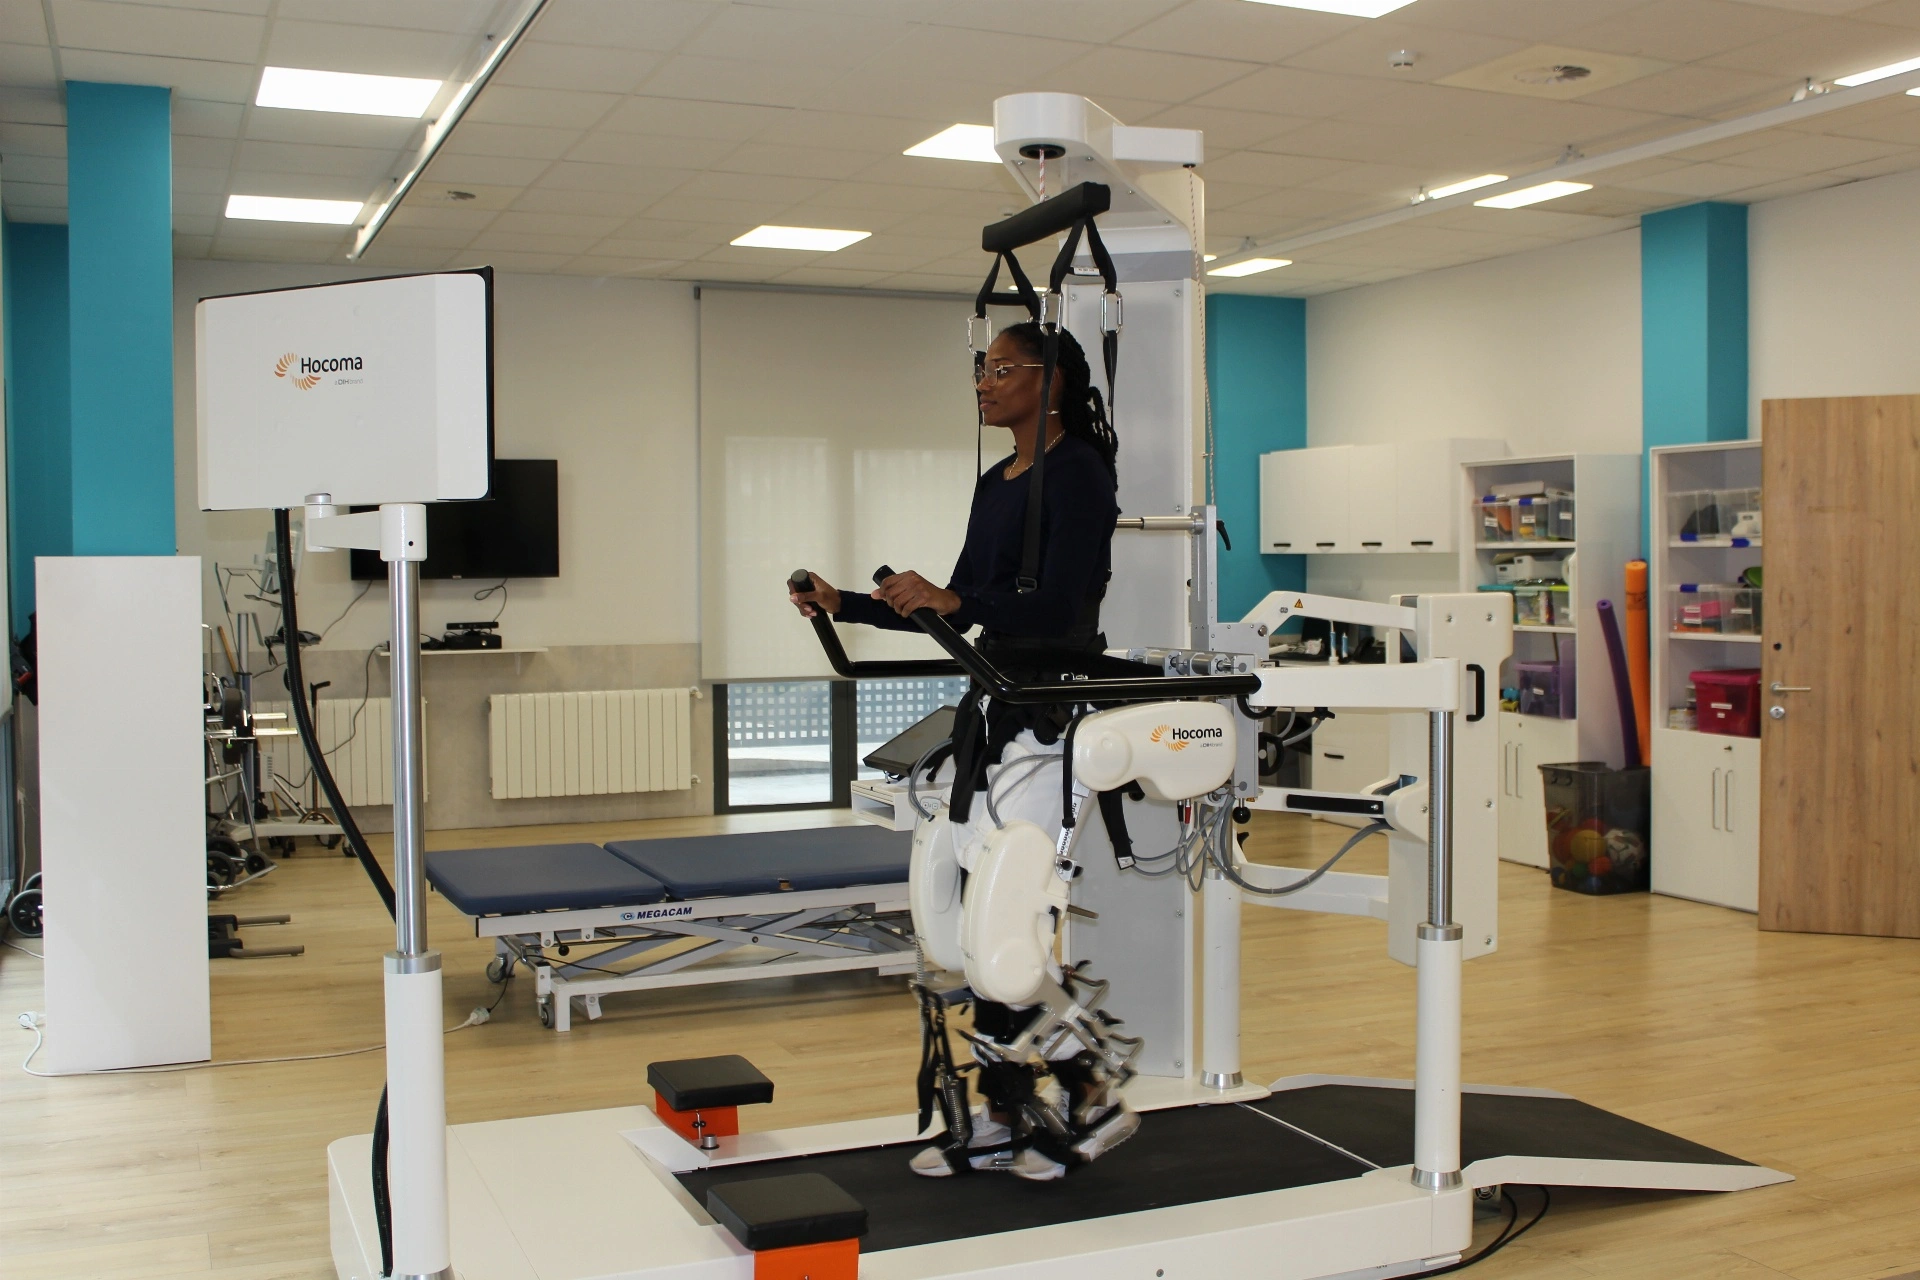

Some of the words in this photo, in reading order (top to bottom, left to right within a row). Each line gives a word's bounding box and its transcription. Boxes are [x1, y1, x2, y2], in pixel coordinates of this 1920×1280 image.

[301, 357, 363, 373] Hocoma
[1172, 727, 1223, 740] Hocoma
[637, 906, 693, 920] MEGACAM
